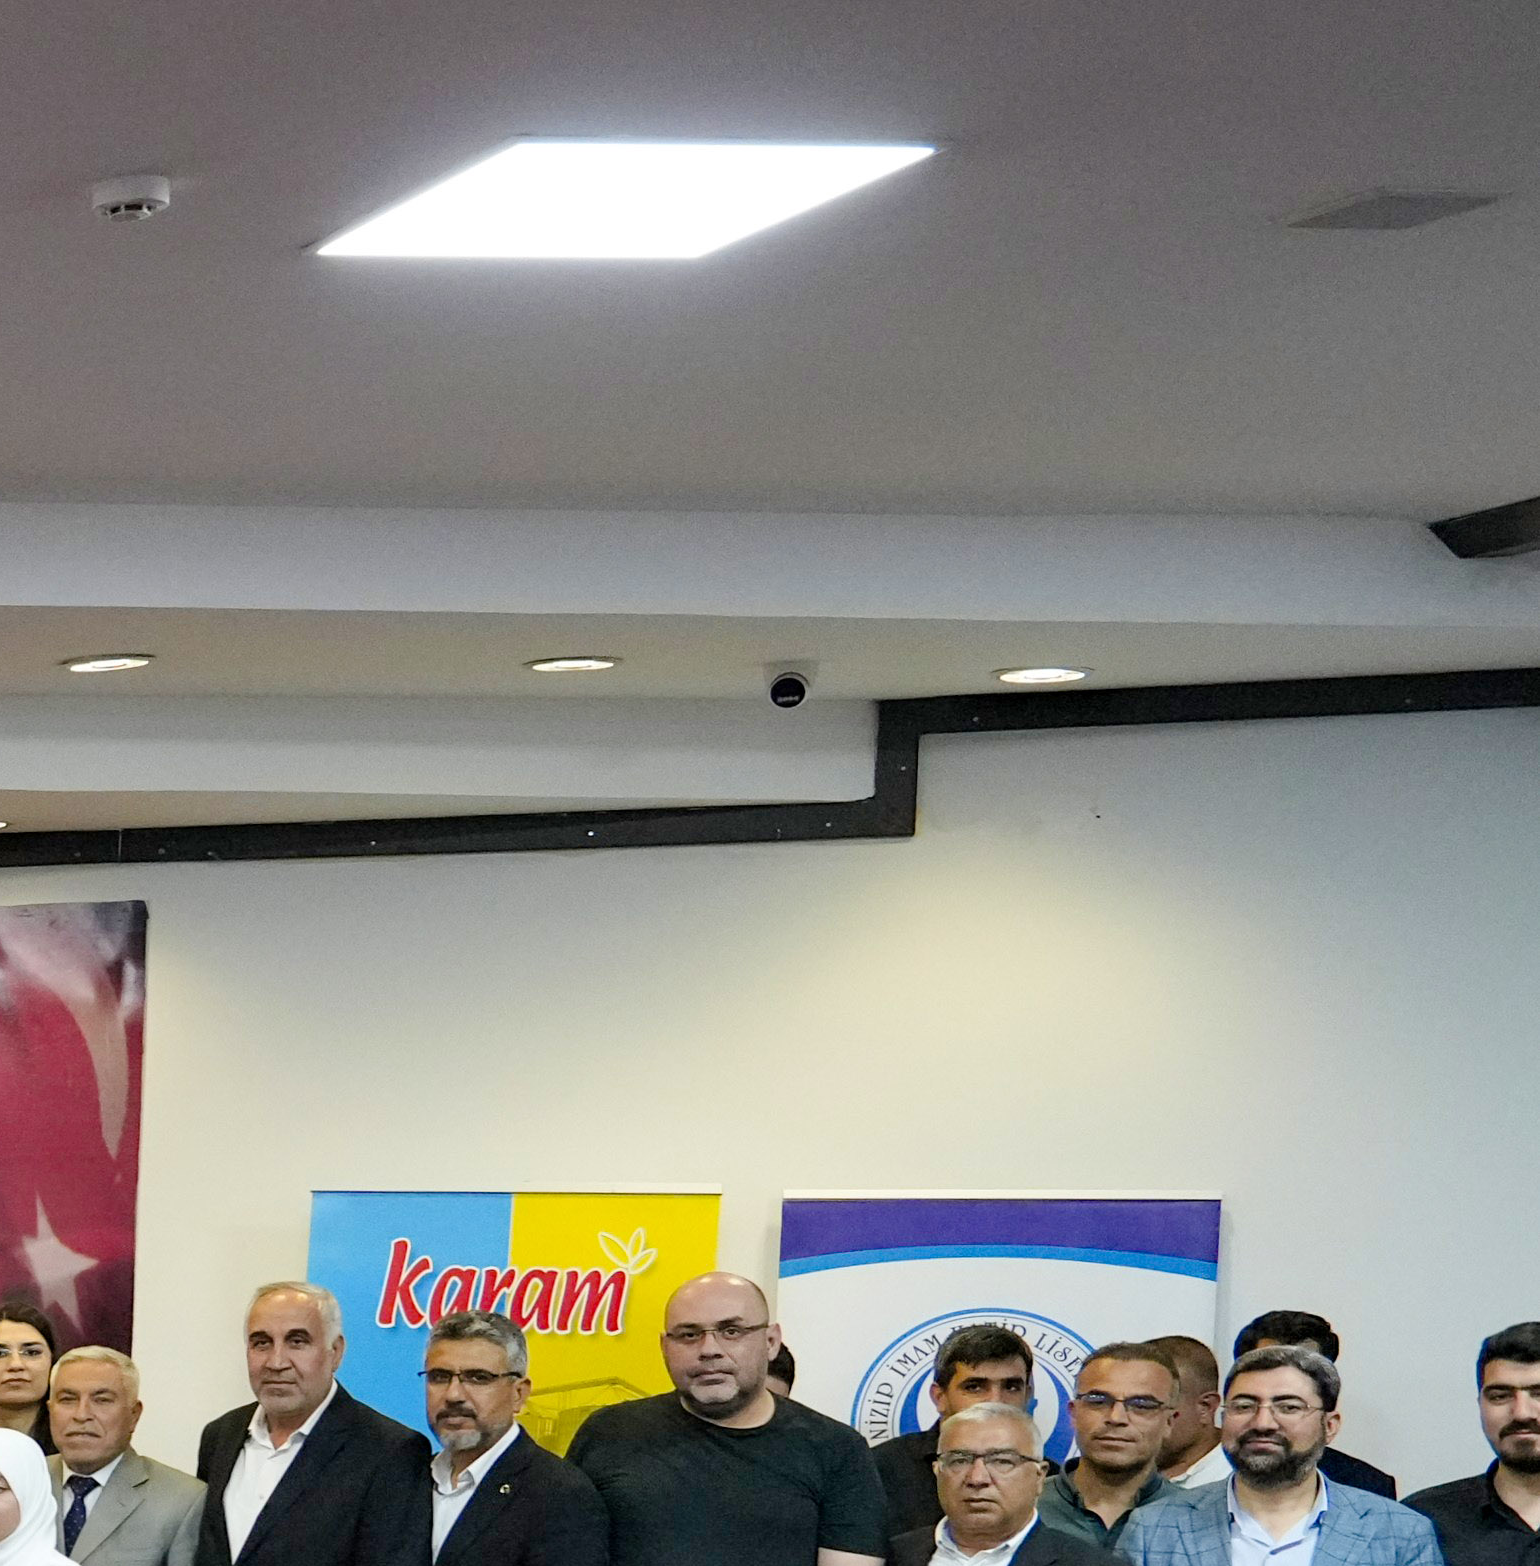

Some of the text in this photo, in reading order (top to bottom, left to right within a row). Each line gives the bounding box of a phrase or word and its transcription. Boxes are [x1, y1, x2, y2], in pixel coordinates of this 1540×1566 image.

[376, 1238, 629, 1336] karam
[865, 1381, 894, 1441] NİZİP
[886, 1334, 942, 1379] İMAM
[1034, 1331, 1081, 1378] LİSE
